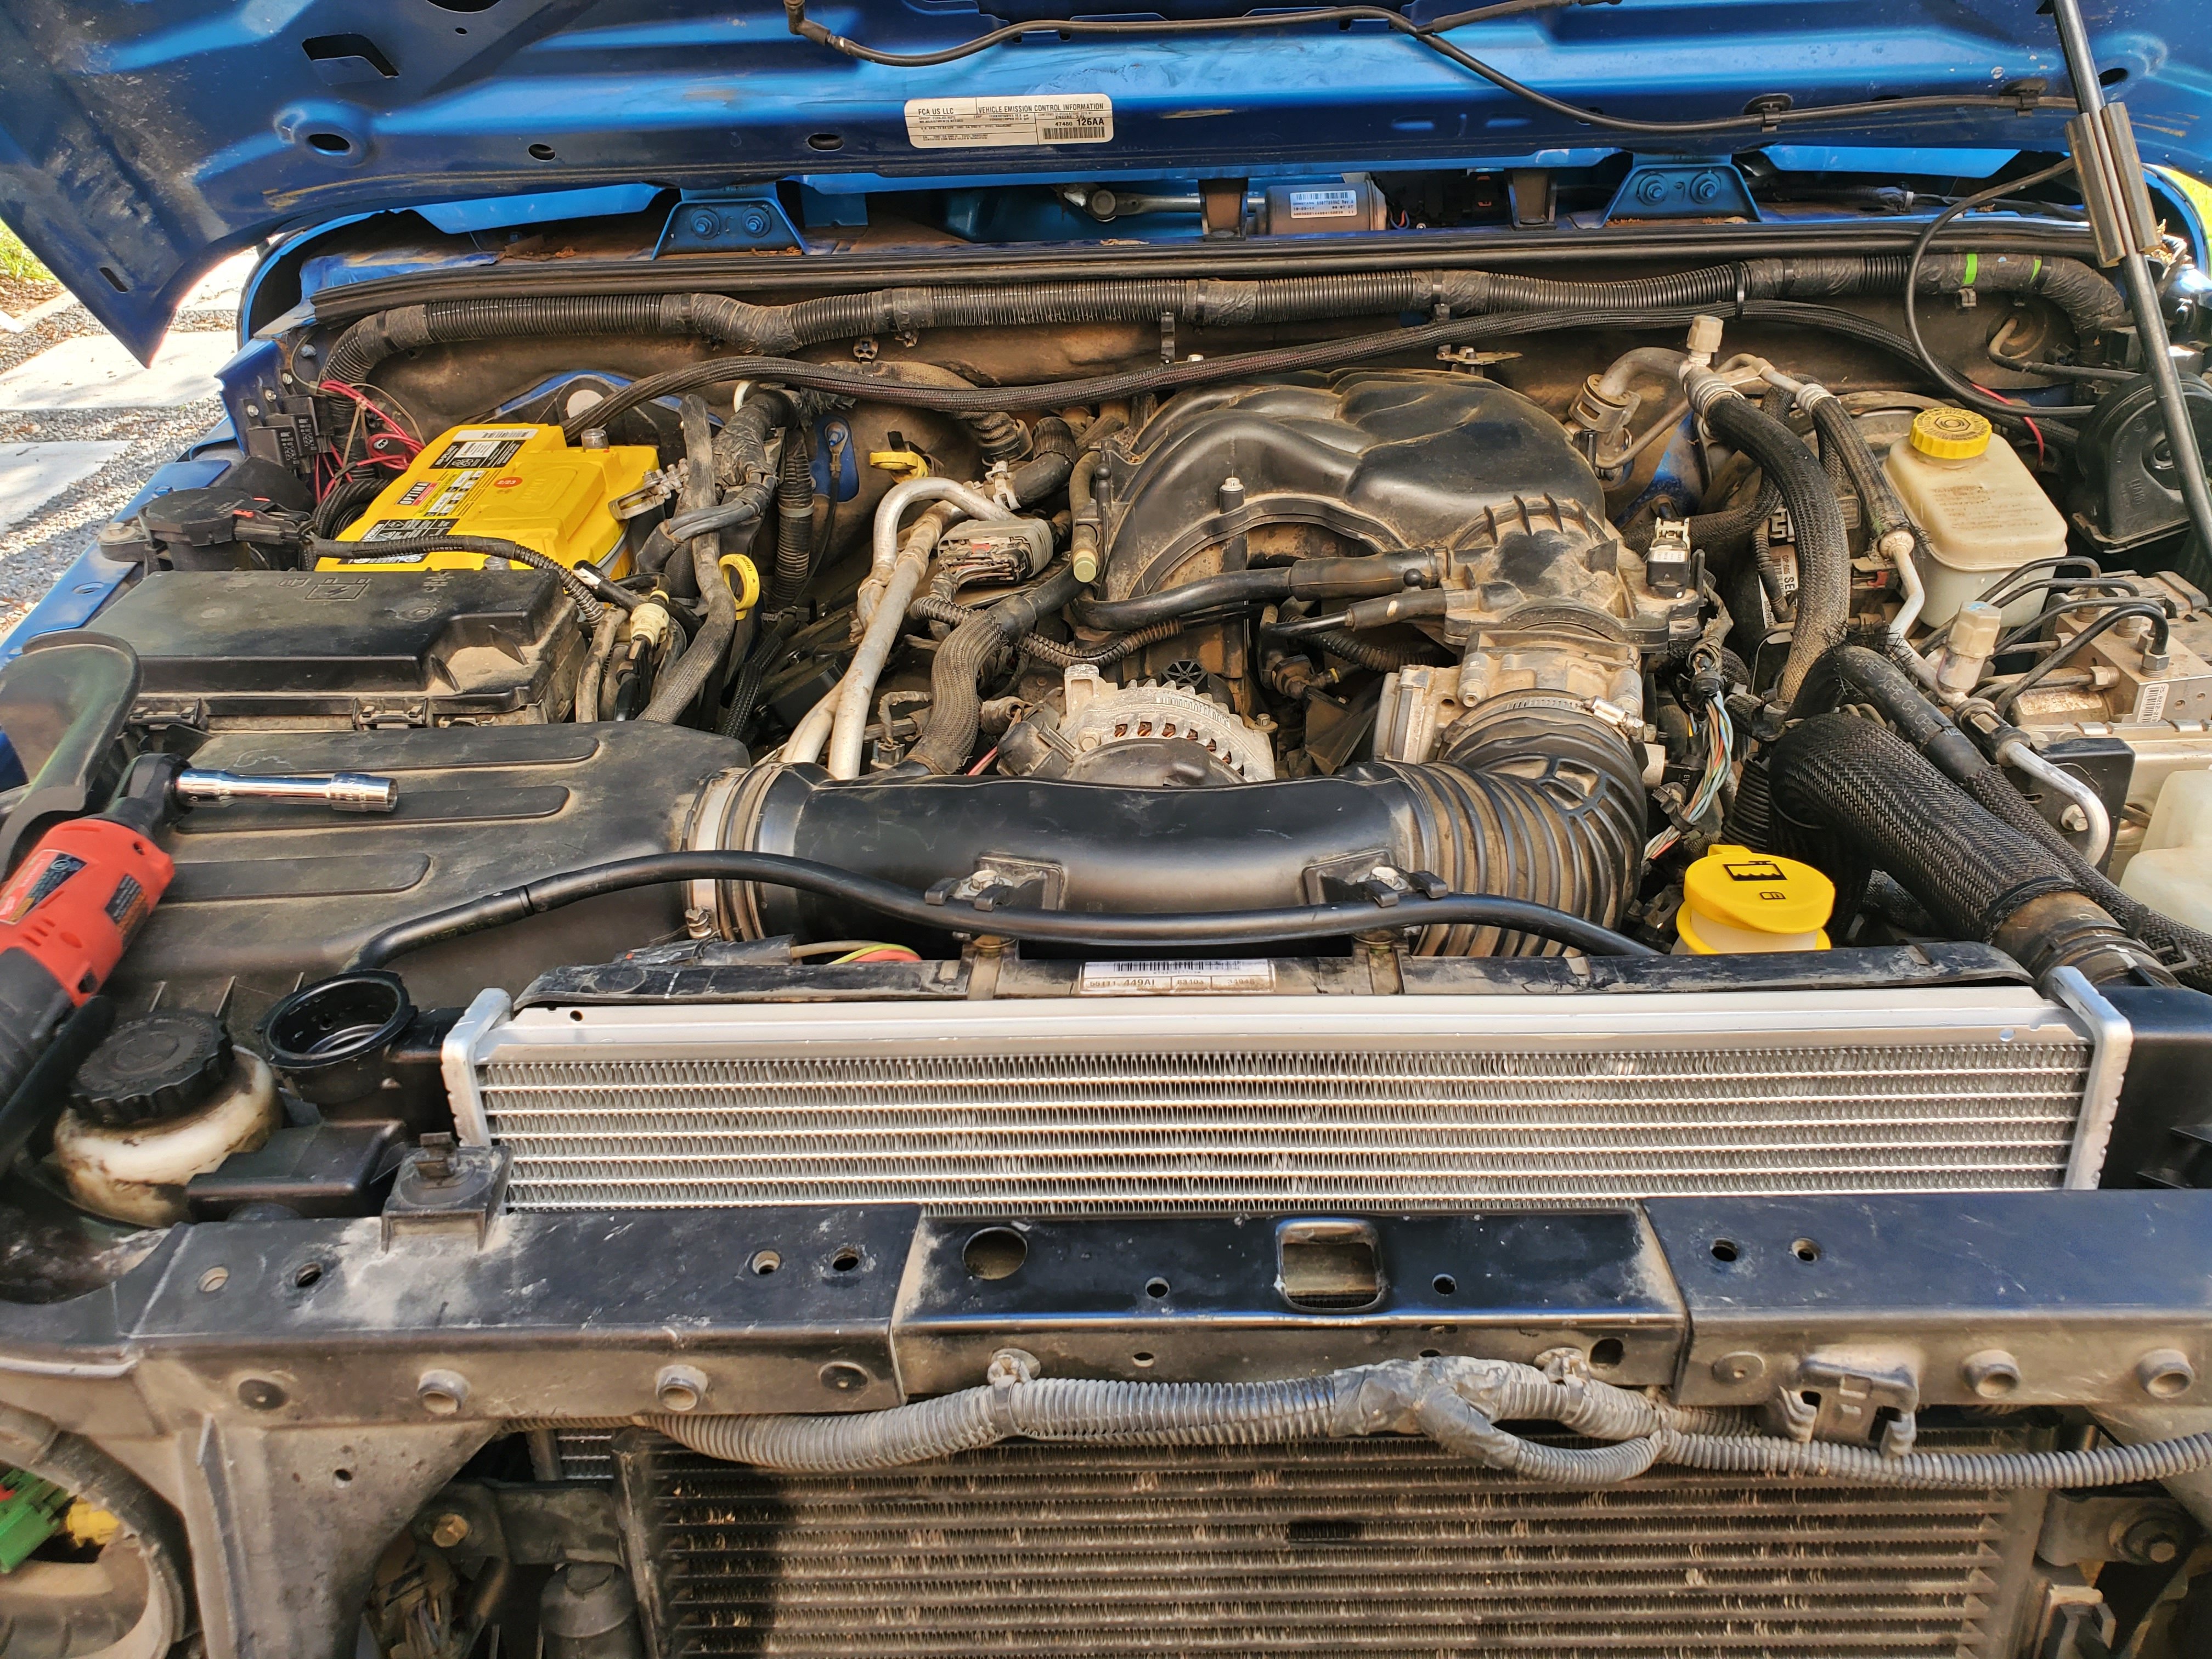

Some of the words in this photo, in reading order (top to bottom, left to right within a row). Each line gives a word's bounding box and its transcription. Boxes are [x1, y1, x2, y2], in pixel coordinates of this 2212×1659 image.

[1063, 103, 1104, 111] INFORMATION
[1076, 117, 1104, 126] 126AA
[399, 482, 430, 505] OPTIMA
